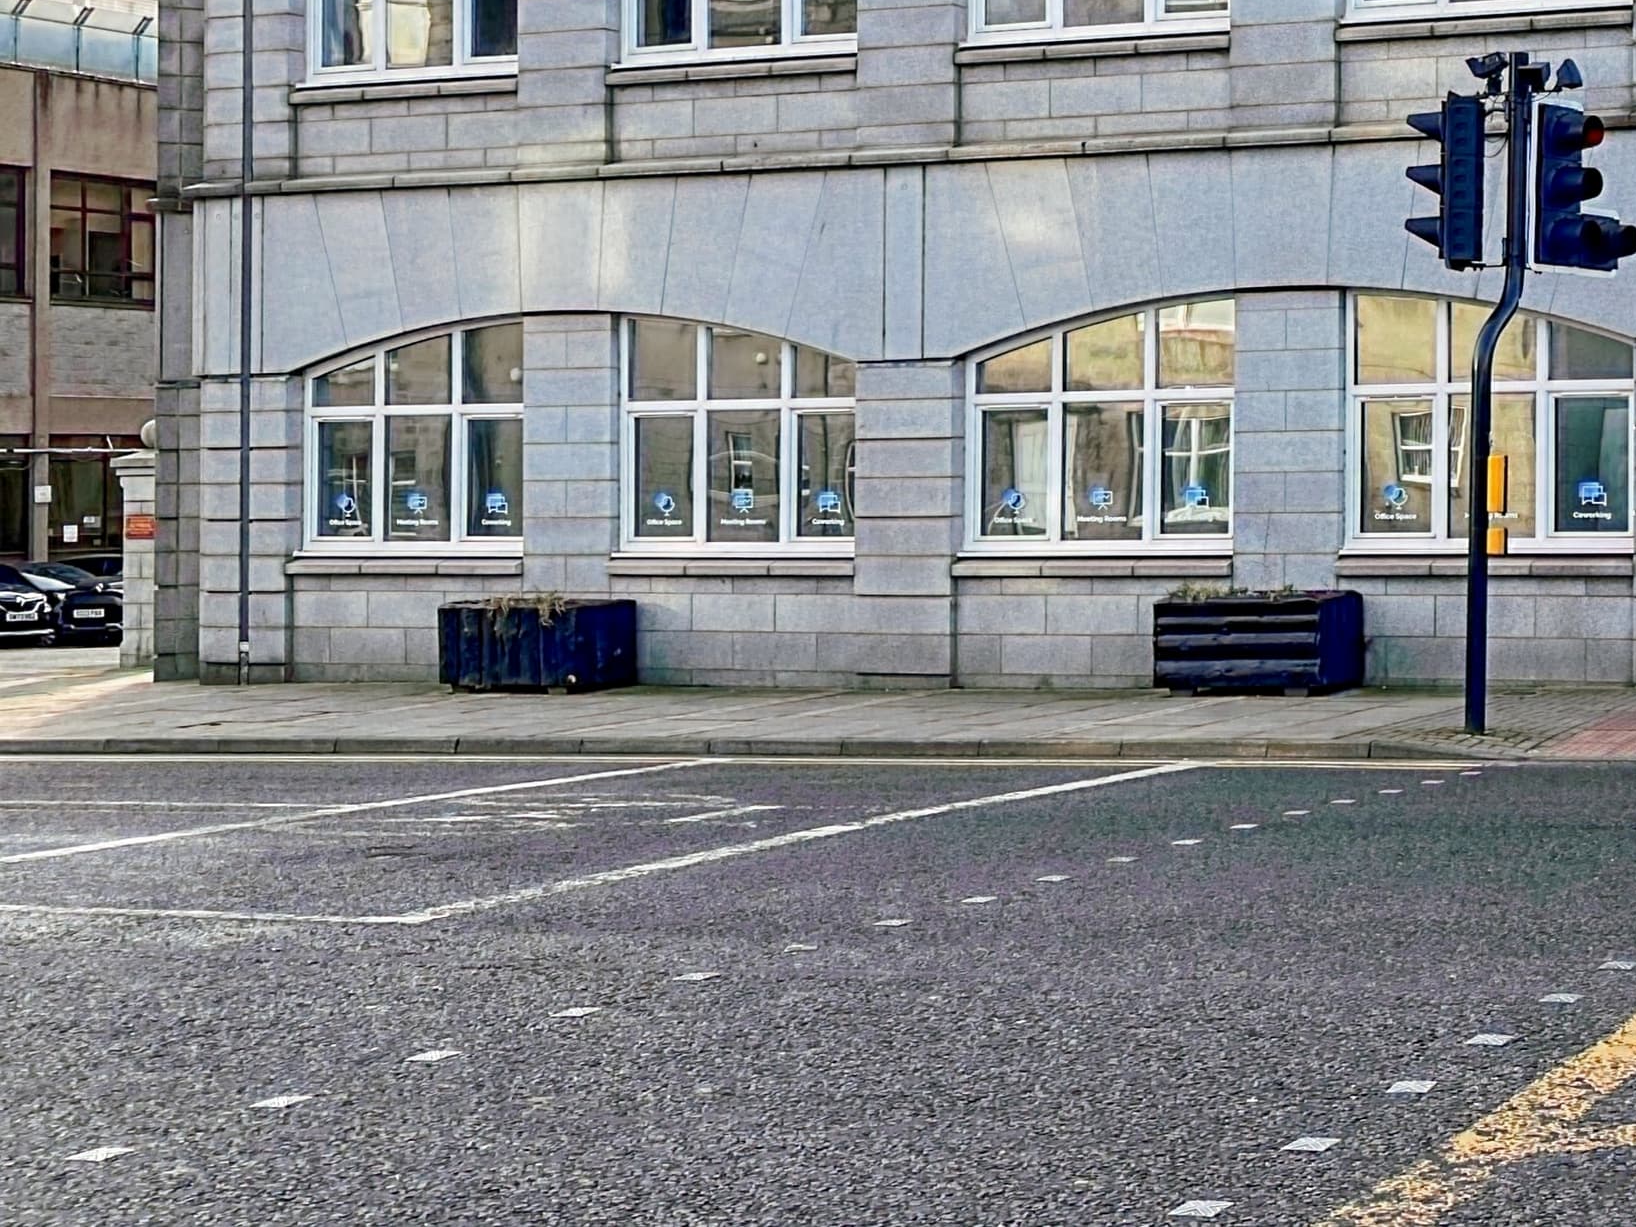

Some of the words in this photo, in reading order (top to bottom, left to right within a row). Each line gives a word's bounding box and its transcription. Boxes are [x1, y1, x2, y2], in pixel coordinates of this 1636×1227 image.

[1077, 515, 1103, 524] Meeting
[1104, 515, 1127, 523] Rooms
[1374, 512, 1394, 520] Office
[1395, 512, 1417, 521] Space
[1573, 512, 1612, 521] Coworking
